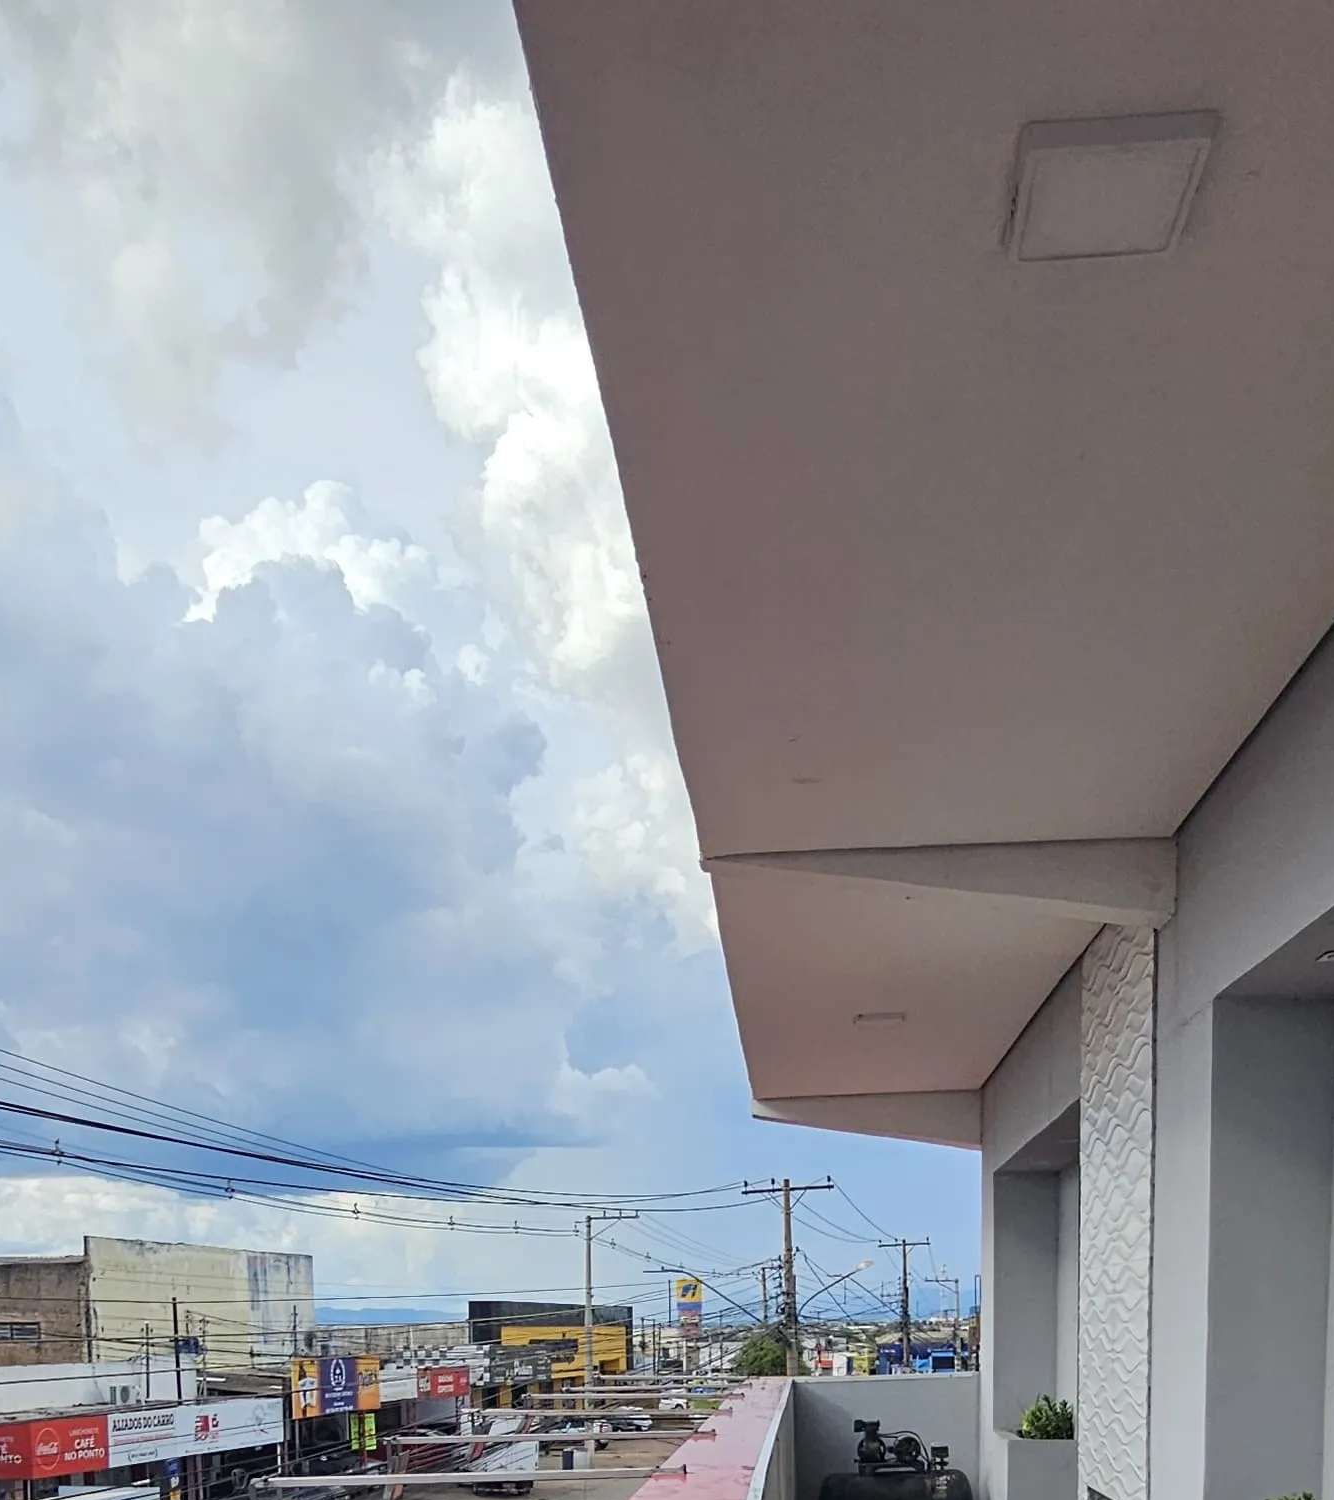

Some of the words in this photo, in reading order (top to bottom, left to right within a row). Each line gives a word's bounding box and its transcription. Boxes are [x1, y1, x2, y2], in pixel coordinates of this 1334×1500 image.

[74, 1435, 96, 1450] CAFÉ
[64, 1451, 77, 1461] NO
[78, 1448, 105, 1460] PONTO
